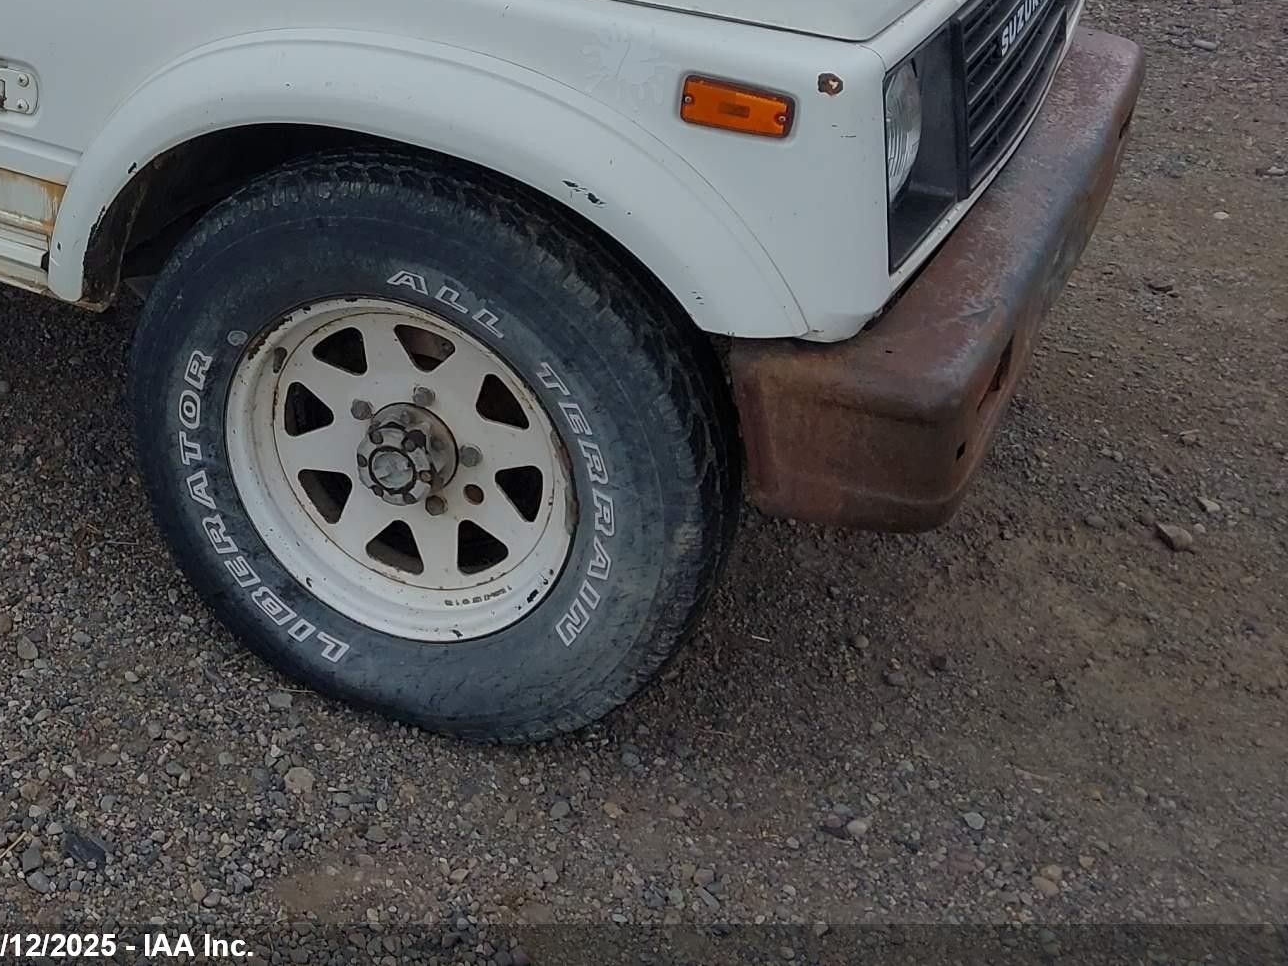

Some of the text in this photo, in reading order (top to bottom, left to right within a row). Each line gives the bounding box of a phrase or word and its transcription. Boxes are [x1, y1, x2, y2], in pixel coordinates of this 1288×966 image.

[177, 350, 351, 663] LIBERATOR
[386, 269, 615, 647] ALL TERRAIN
